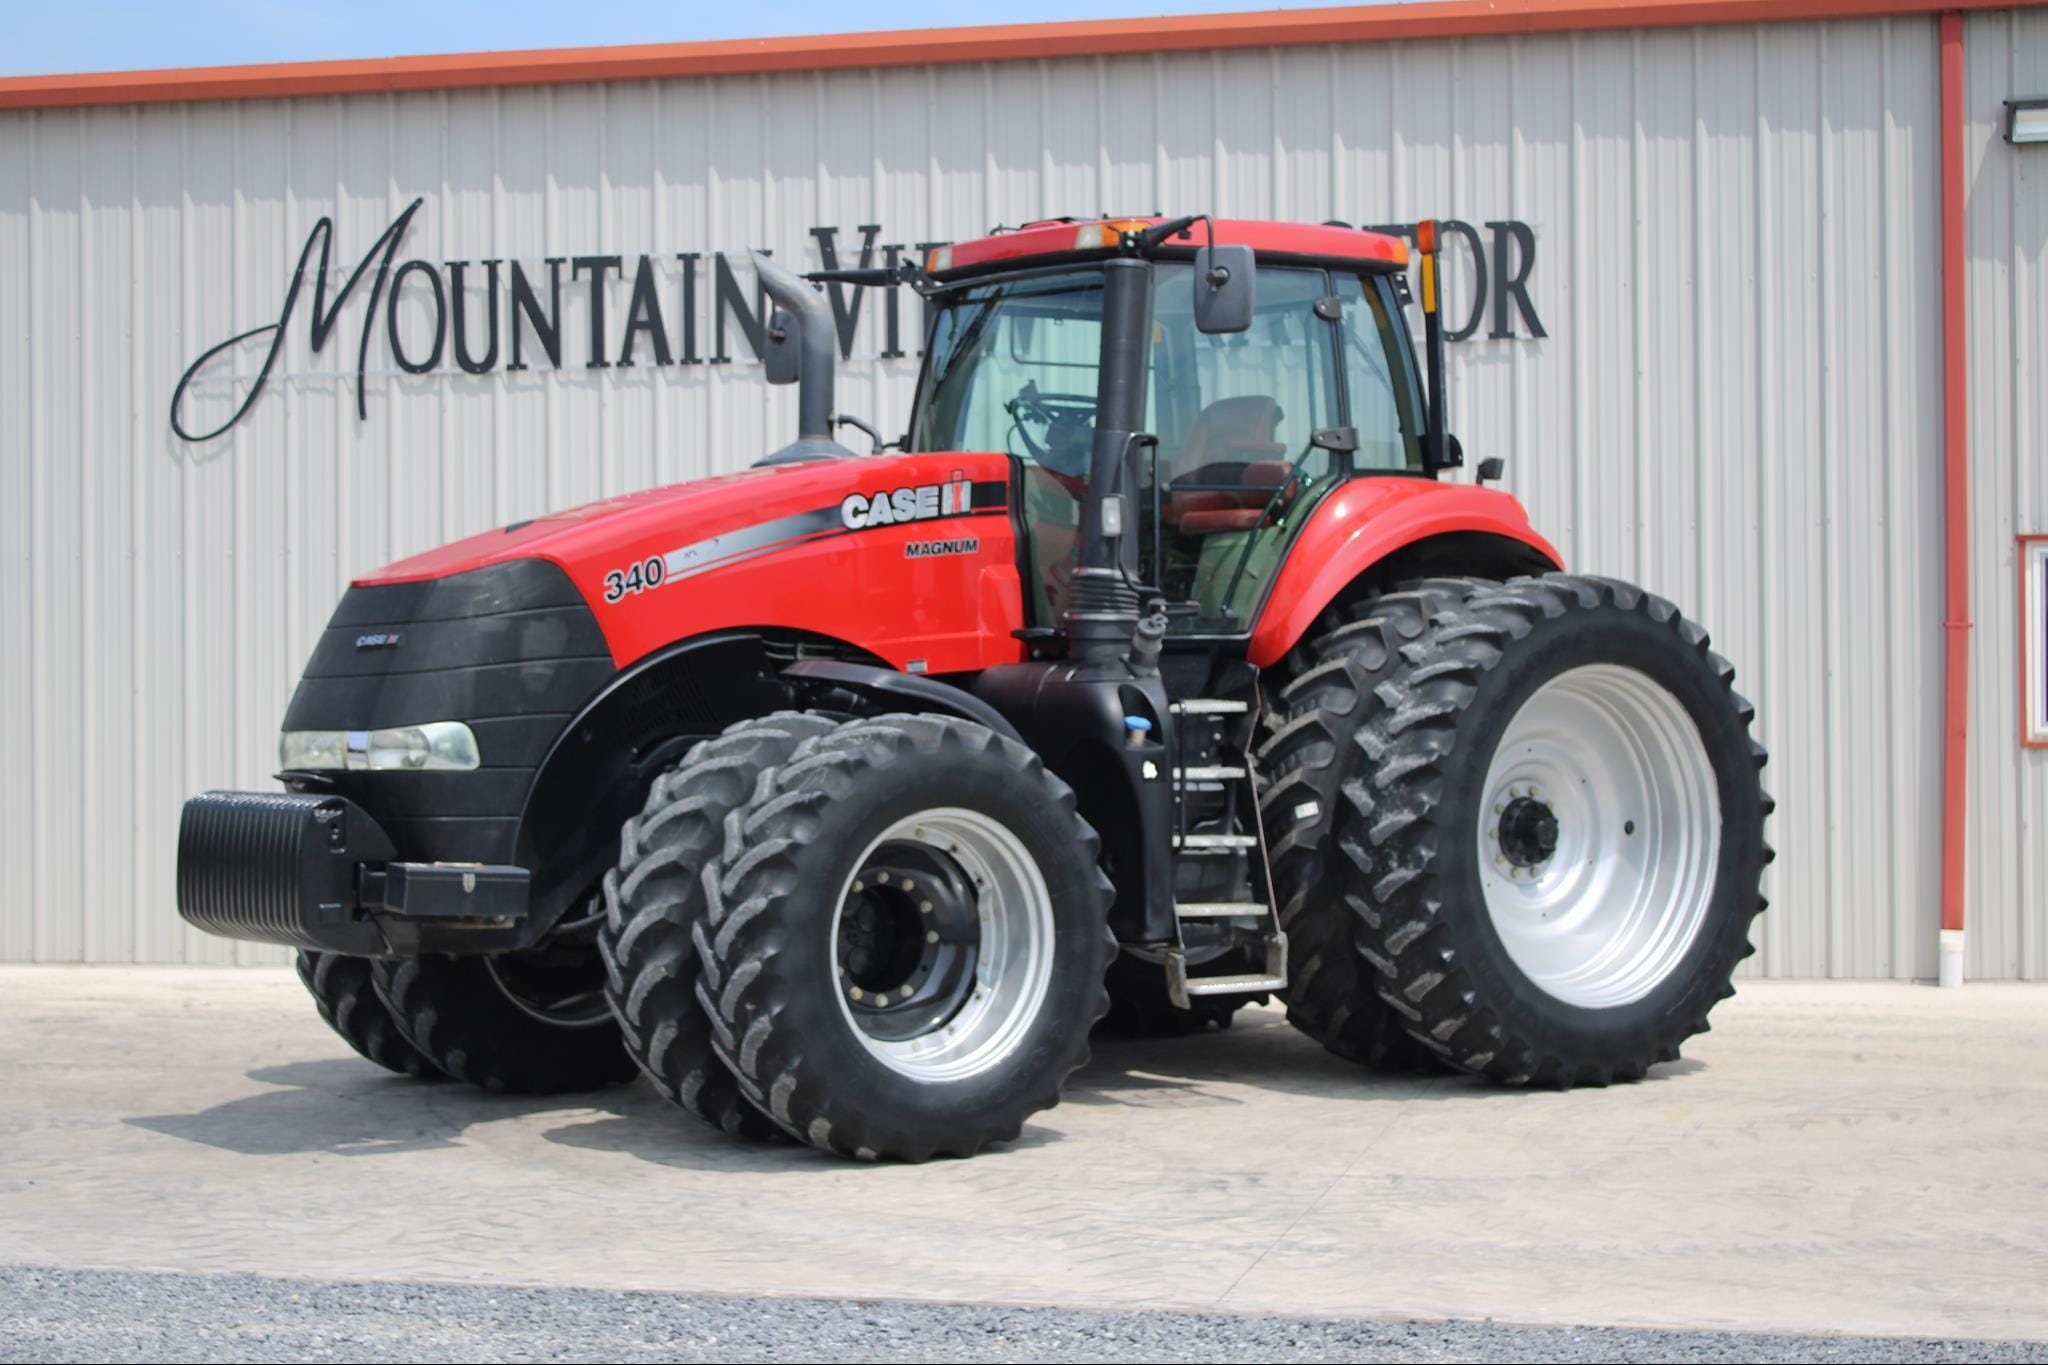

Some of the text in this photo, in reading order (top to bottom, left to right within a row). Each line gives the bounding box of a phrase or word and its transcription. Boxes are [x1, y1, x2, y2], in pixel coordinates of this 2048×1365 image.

[171, 196, 773, 441] MOUNTAIN
[841, 485, 940, 530] CASE
[906, 538, 978, 558] MAGNUM
[604, 556, 664, 603] 340
